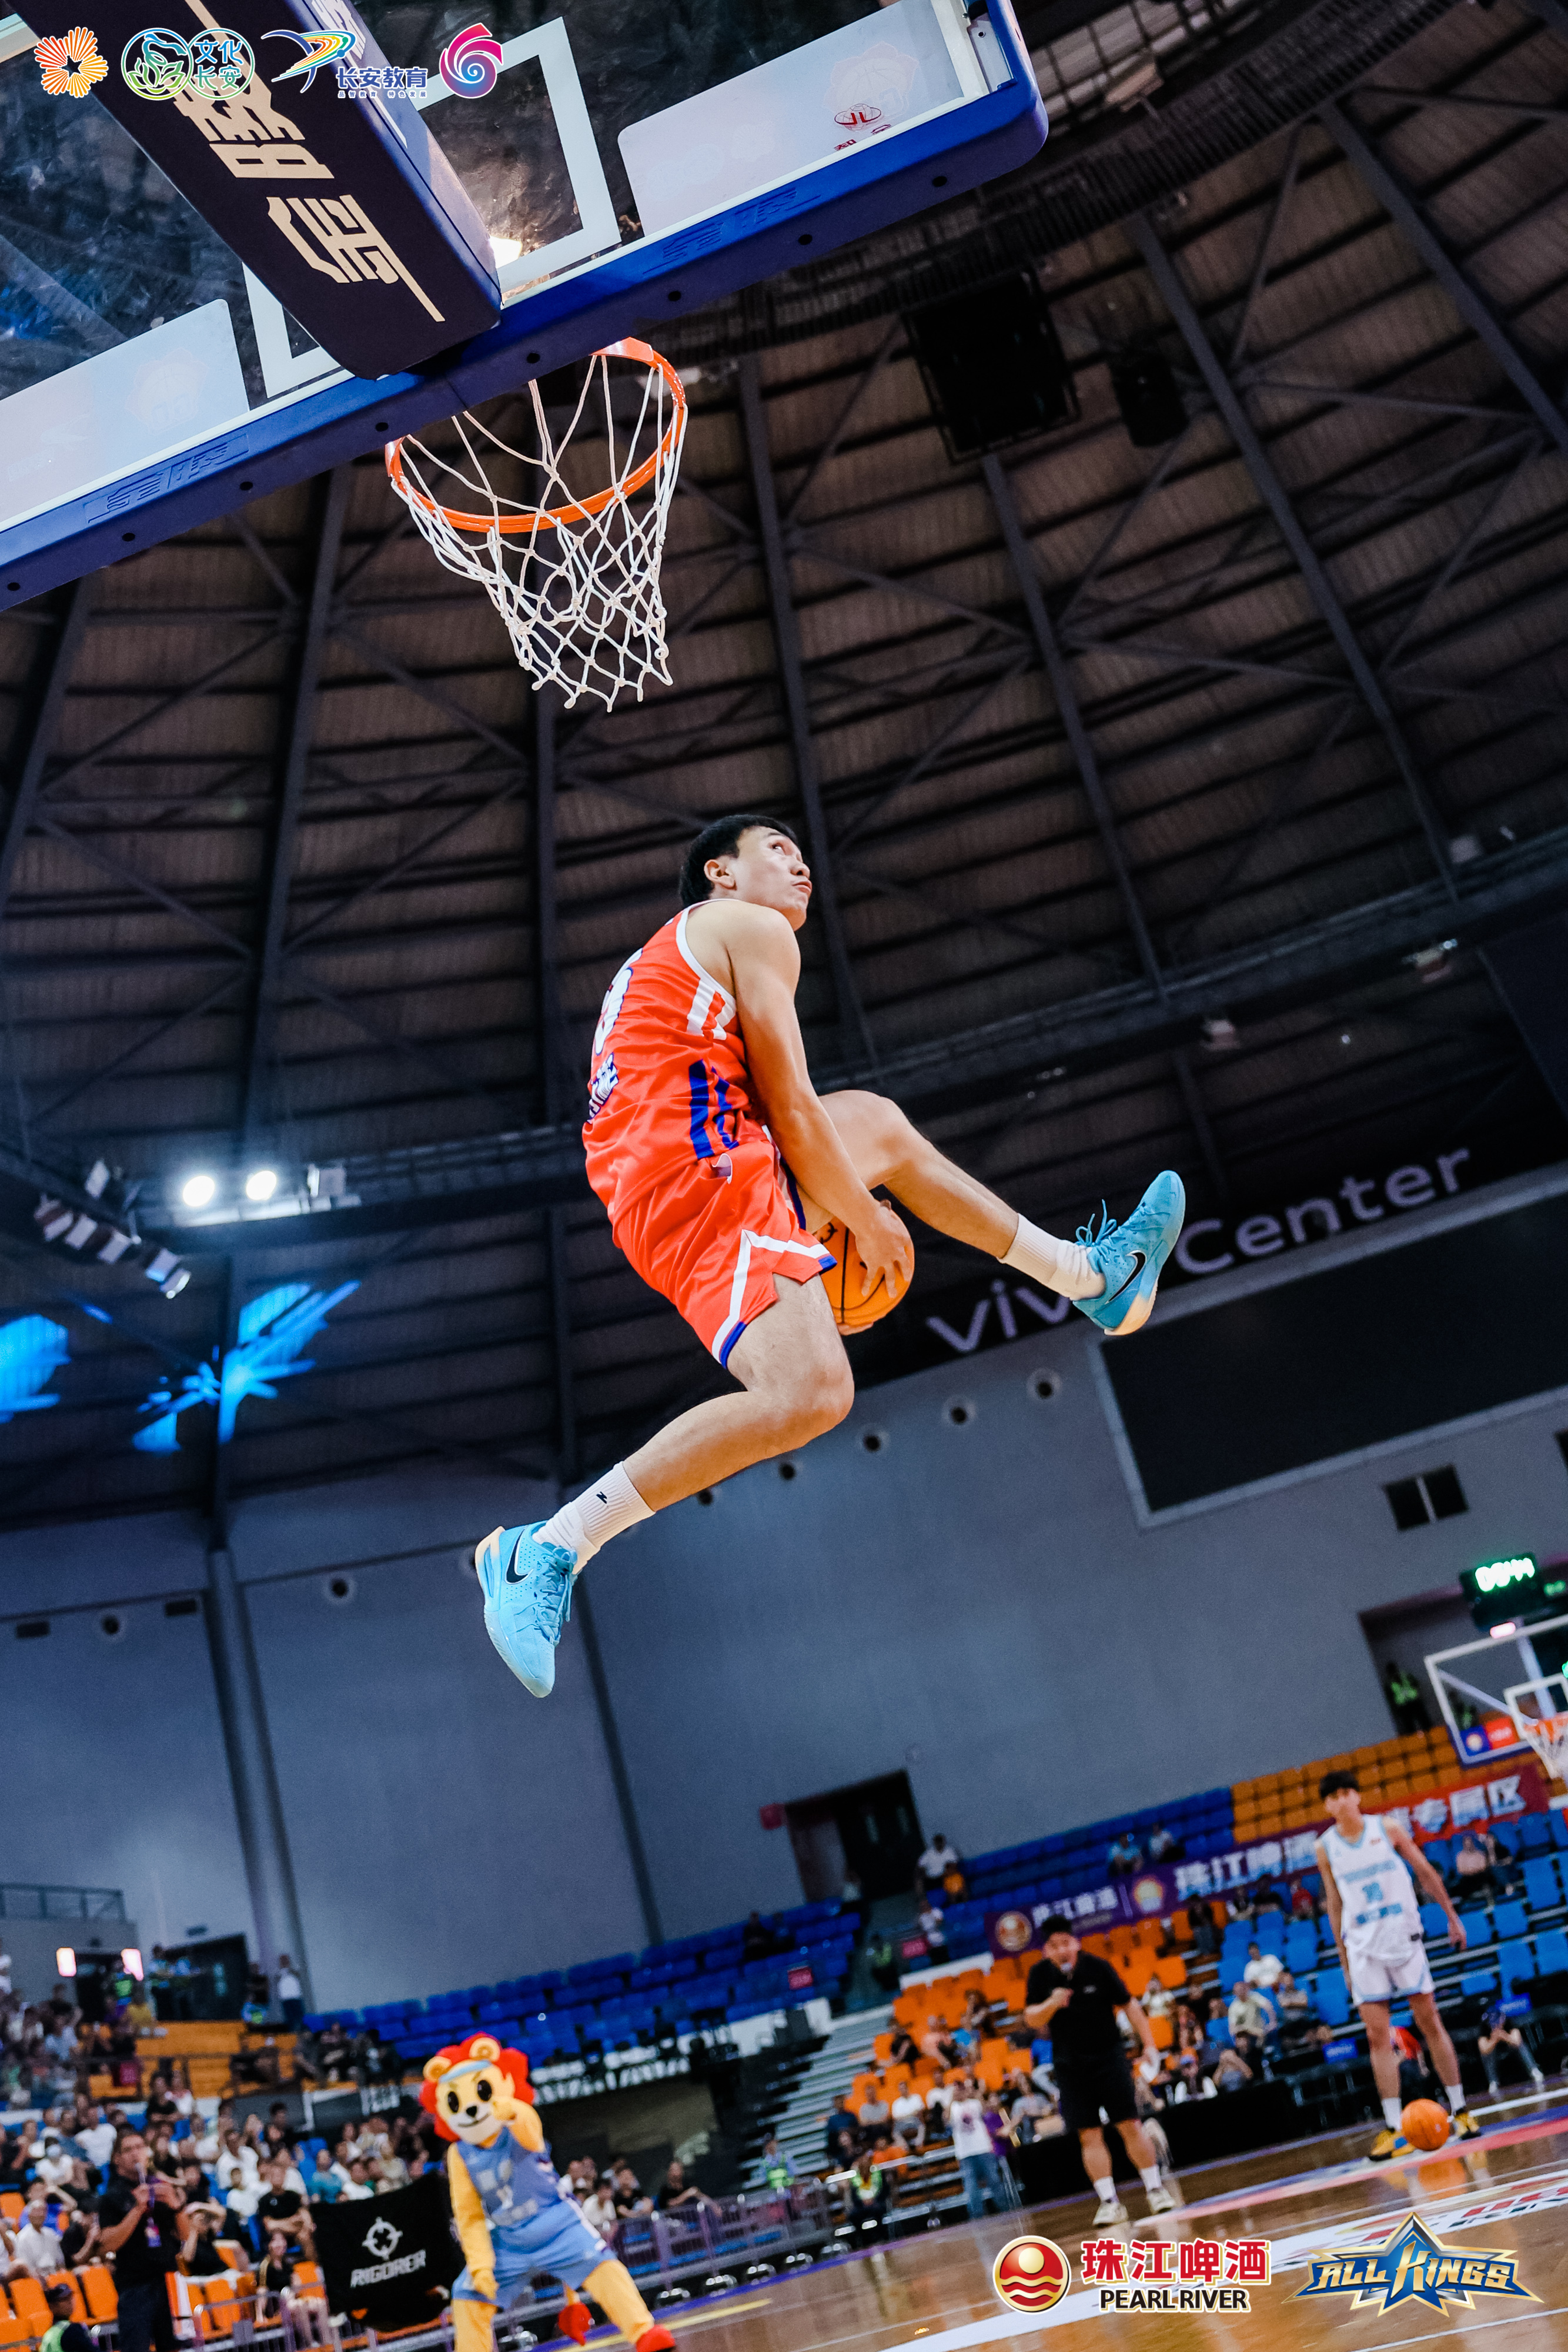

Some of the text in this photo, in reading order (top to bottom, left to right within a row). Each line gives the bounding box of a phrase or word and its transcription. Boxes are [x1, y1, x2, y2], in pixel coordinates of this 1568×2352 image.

[926, 1148, 1471, 1353] viv Center
[350, 2249, 426, 2288] RIGORER
